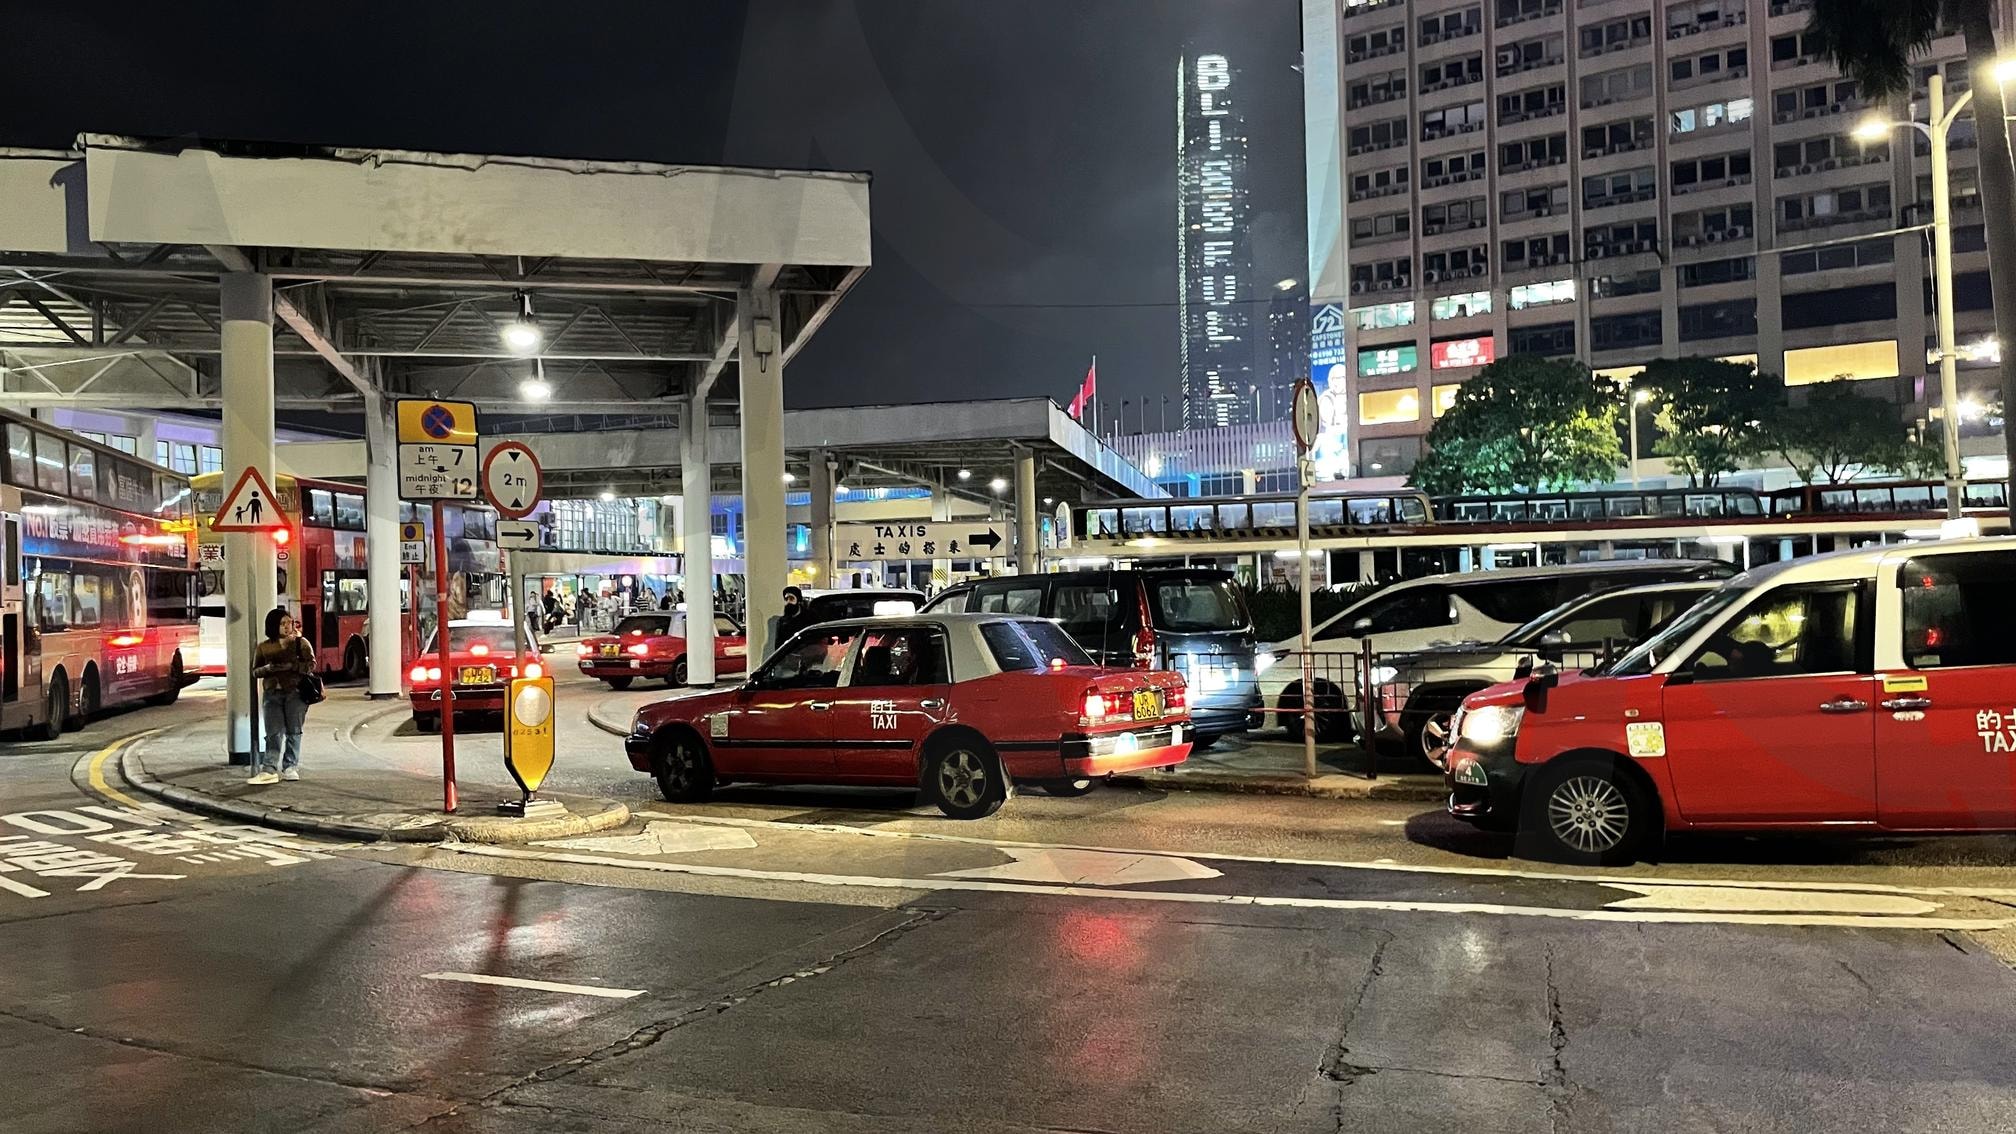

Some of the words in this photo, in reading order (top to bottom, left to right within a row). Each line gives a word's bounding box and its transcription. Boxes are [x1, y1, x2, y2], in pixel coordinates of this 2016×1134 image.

[414, 454, 438, 465] 上午
[451, 448, 464, 466] 7
[405, 474, 446, 483] midnight
[504, 473, 512, 486] 2
[516, 477, 527, 487] m
[415, 484, 440, 495] 午夜
[451, 477, 472, 495] 12
[874, 525, 927, 538] TAXIS
[870, 699, 897, 714] 的士
[1139, 694, 1149, 706] UR
[1136, 705, 1157, 719] 6062
[870, 714, 897, 730] TAXI
[1465, 766, 1472, 776] 4
